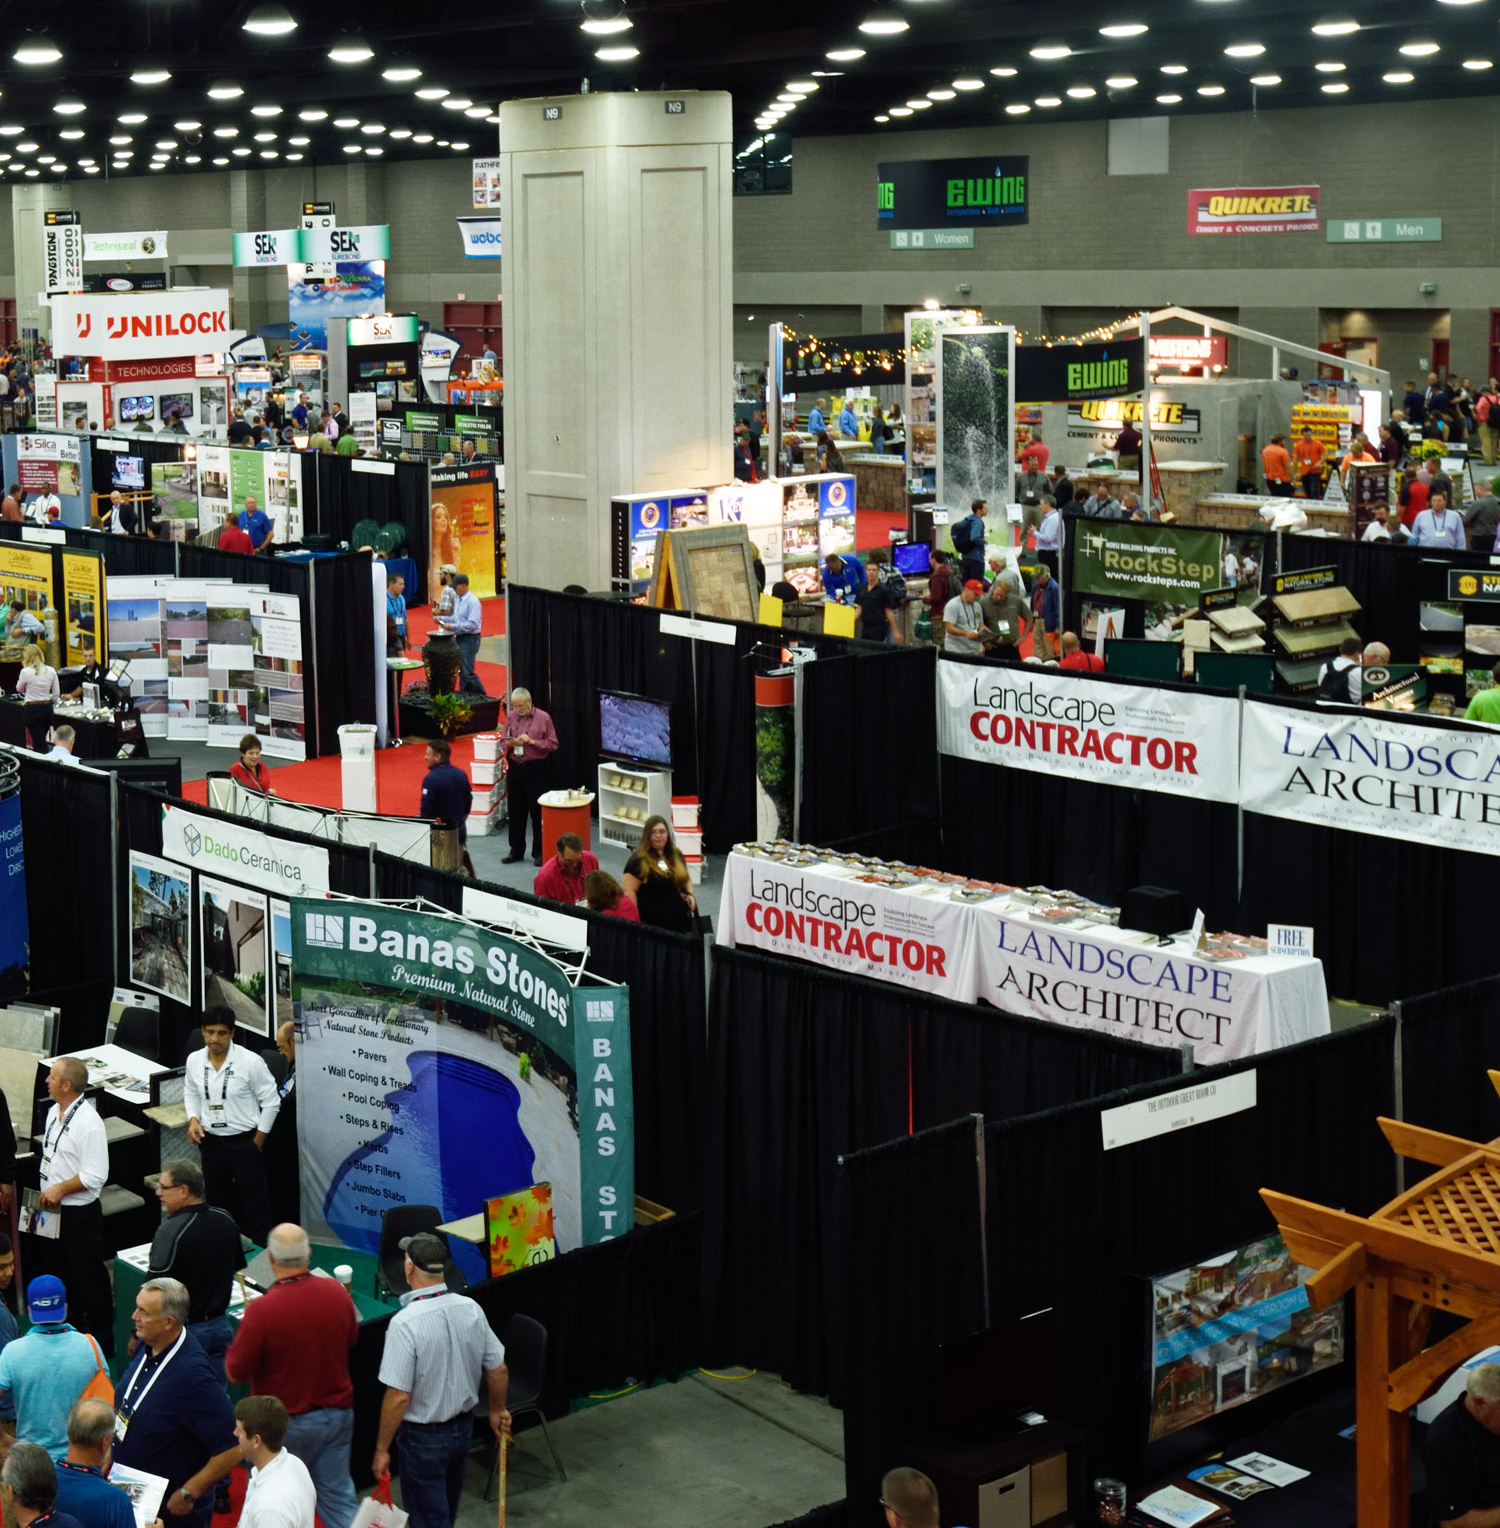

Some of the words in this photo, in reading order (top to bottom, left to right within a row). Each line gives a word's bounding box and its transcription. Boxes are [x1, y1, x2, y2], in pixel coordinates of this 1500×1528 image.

[546, 108, 558, 119] N9
[668, 102, 682, 112] N9
[947, 176, 1024, 207] EWING
[1208, 194, 1312, 216] QUIKRETE
[934, 234, 968, 244] Women
[1236, 224, 1284, 233] CONCRETE
[1396, 224, 1424, 236] Men
[64, 228, 74, 278] 22000
[93, 240, 137, 252] Techniseal
[48, 231, 56, 288] PAVESTONE
[108, 311, 226, 339] UNILOCK
[118, 364, 192, 377] TECHNOLOGIES
[1068, 359, 1128, 391] EWING
[1068, 430, 1098, 439] CEMENT
[1153, 435, 1198, 444] PRODUCTS
[431, 472, 456, 482] Making
[457, 472, 468, 480] life
[470, 469, 488, 478] EASY
[1120, 542, 1142, 552] BUILDING
[1143, 544, 1163, 554] PRODUCTS
[1164, 546, 1178, 556] INC.
[1104, 550, 1214, 582] RockStep
[1105, 570, 1200, 589] www.rocksteps.com
[1284, 578, 1312, 589] NATURAL
[1313, 576, 1335, 584] STONE
[1372, 672, 1420, 701] Architectural
[973, 678, 1116, 732] Landscape
[969, 710, 1198, 776] CONTRACTOR
[1280, 766, 1500, 826] ARCHITE
[750, 868, 876, 930] Landscape
[746, 902, 947, 978] CONTRACTOR
[1277, 928, 1306, 947] FREE
[997, 919, 1232, 1004] LANDSCAPE
[1270, 946, 1311, 958] SUBSCRIPTION
[349, 916, 476, 975] Banas
[486, 946, 568, 1028] Stones
[868, 964, 916, 982] MAINTAIN
[391, 964, 456, 995] Premium
[460, 982, 508, 1015] Natural
[510, 1000, 536, 1028] Stone
[996, 964, 1232, 1047] ARCHITECT
[308, 1002, 328, 1013] Next
[329, 1005, 370, 1020] Generation
[370, 1012, 380, 1026] of
[382, 1016, 430, 1036] Evolutionary
[324, 1020, 356, 1034] Natural
[358, 1024, 378, 1039] Stone
[380, 1030, 414, 1046] Products
[358, 1048, 388, 1064] Pavers
[328, 1064, 346, 1078] Wall
[348, 1068, 380, 1087] Coping
[381, 1076, 388, 1086] &
[389, 1078, 418, 1093] Treads
[348, 1091, 368, 1105] Pool
[370, 1095, 400, 1114] Coping
[592, 1038, 618, 1158] BANAS
[1148, 1102, 1158, 1113] THE
[1158, 1094, 1180, 1111] OUTDOOR
[1180, 1090, 1196, 1106] GREAT
[1196, 1086, 1210, 1102] ROOM
[1210, 1084, 1217, 1096] CO
[345, 1114, 370, 1130] Steps
[371, 1119, 379, 1130] &
[380, 1120, 404, 1136] Rises
[362, 1140, 389, 1156] Kerbs
[354, 1159, 374, 1175] Step
[374, 1163, 401, 1180] Fillers
[352, 1181, 382, 1198] Jumbo
[382, 1186, 406, 1203] Slabs
[361, 1204, 379, 1218] Pier
